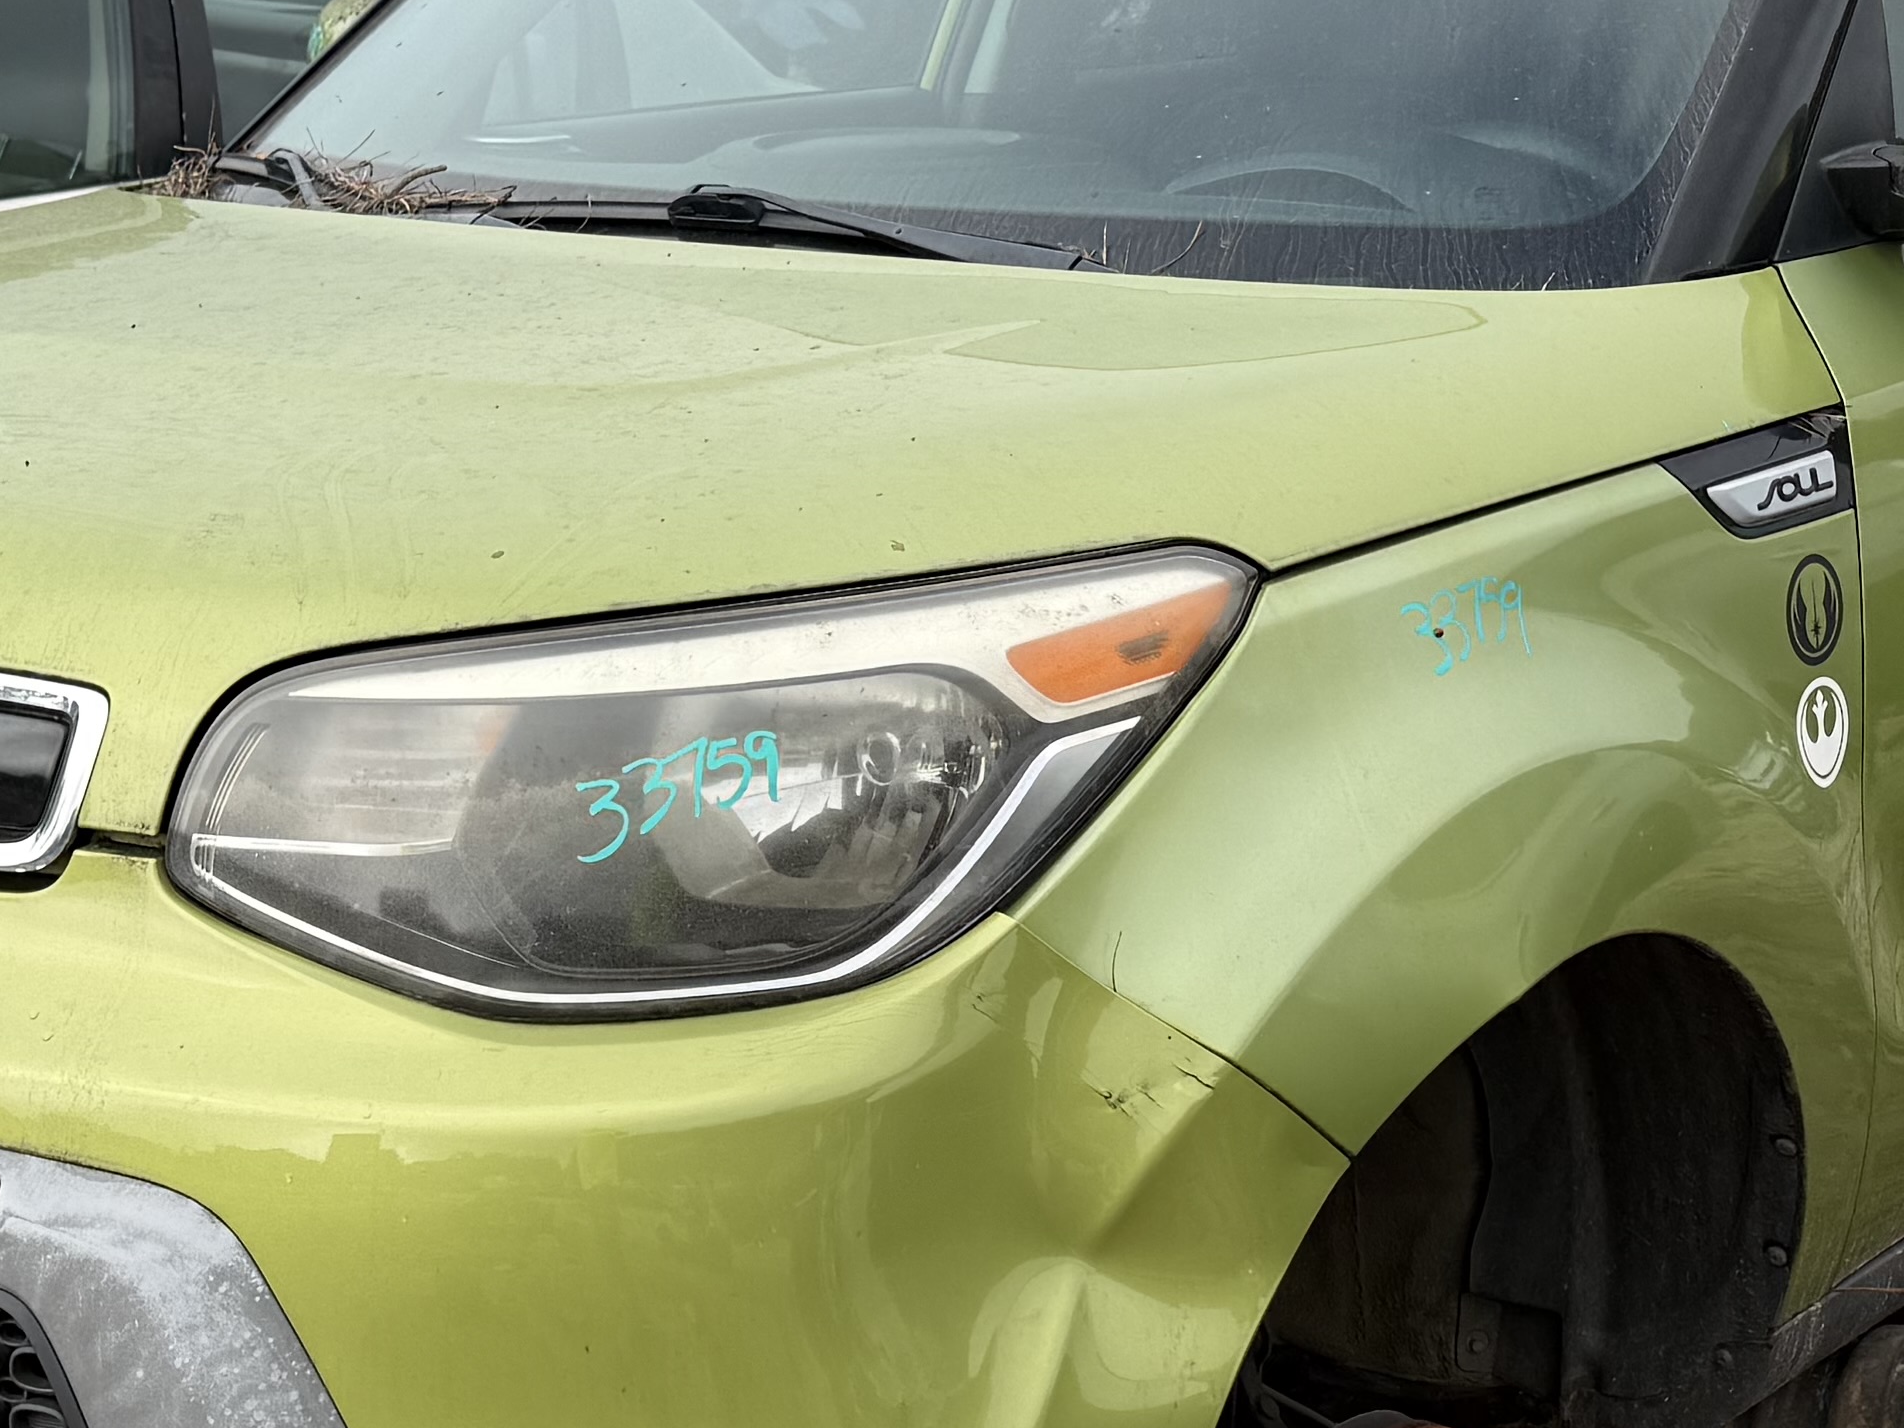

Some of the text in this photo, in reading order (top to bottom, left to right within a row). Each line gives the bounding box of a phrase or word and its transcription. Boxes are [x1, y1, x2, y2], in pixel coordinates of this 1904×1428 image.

[1757, 467, 1834, 511] SOUL
[1400, 575, 1533, 677] 33759
[575, 730, 781, 864] 33759
